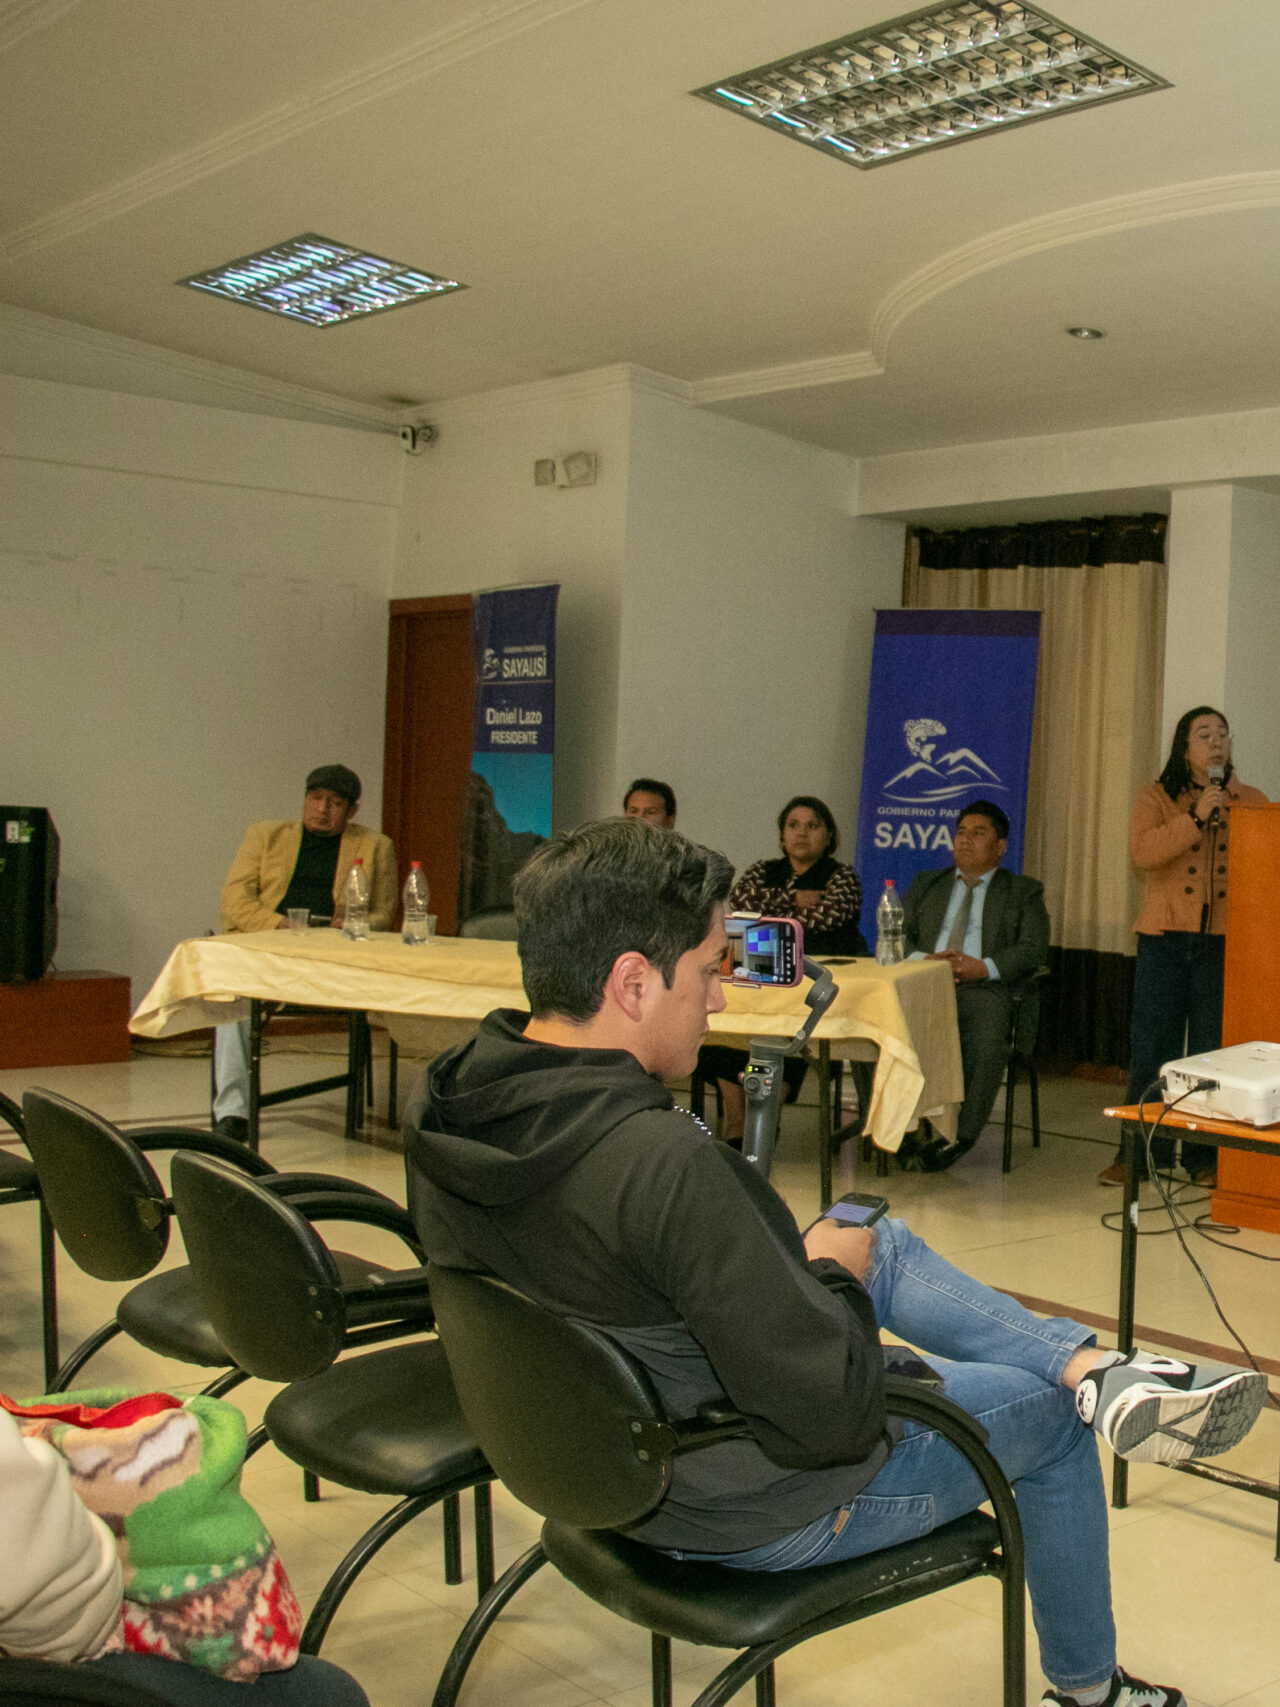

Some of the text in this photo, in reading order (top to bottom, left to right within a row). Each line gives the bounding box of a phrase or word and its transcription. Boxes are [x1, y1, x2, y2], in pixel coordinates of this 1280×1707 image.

[486, 707, 542, 724] Daniel Lazo
[490, 730, 538, 744] PRESIDENTE
[877, 806, 936, 817] GOBIERNO
